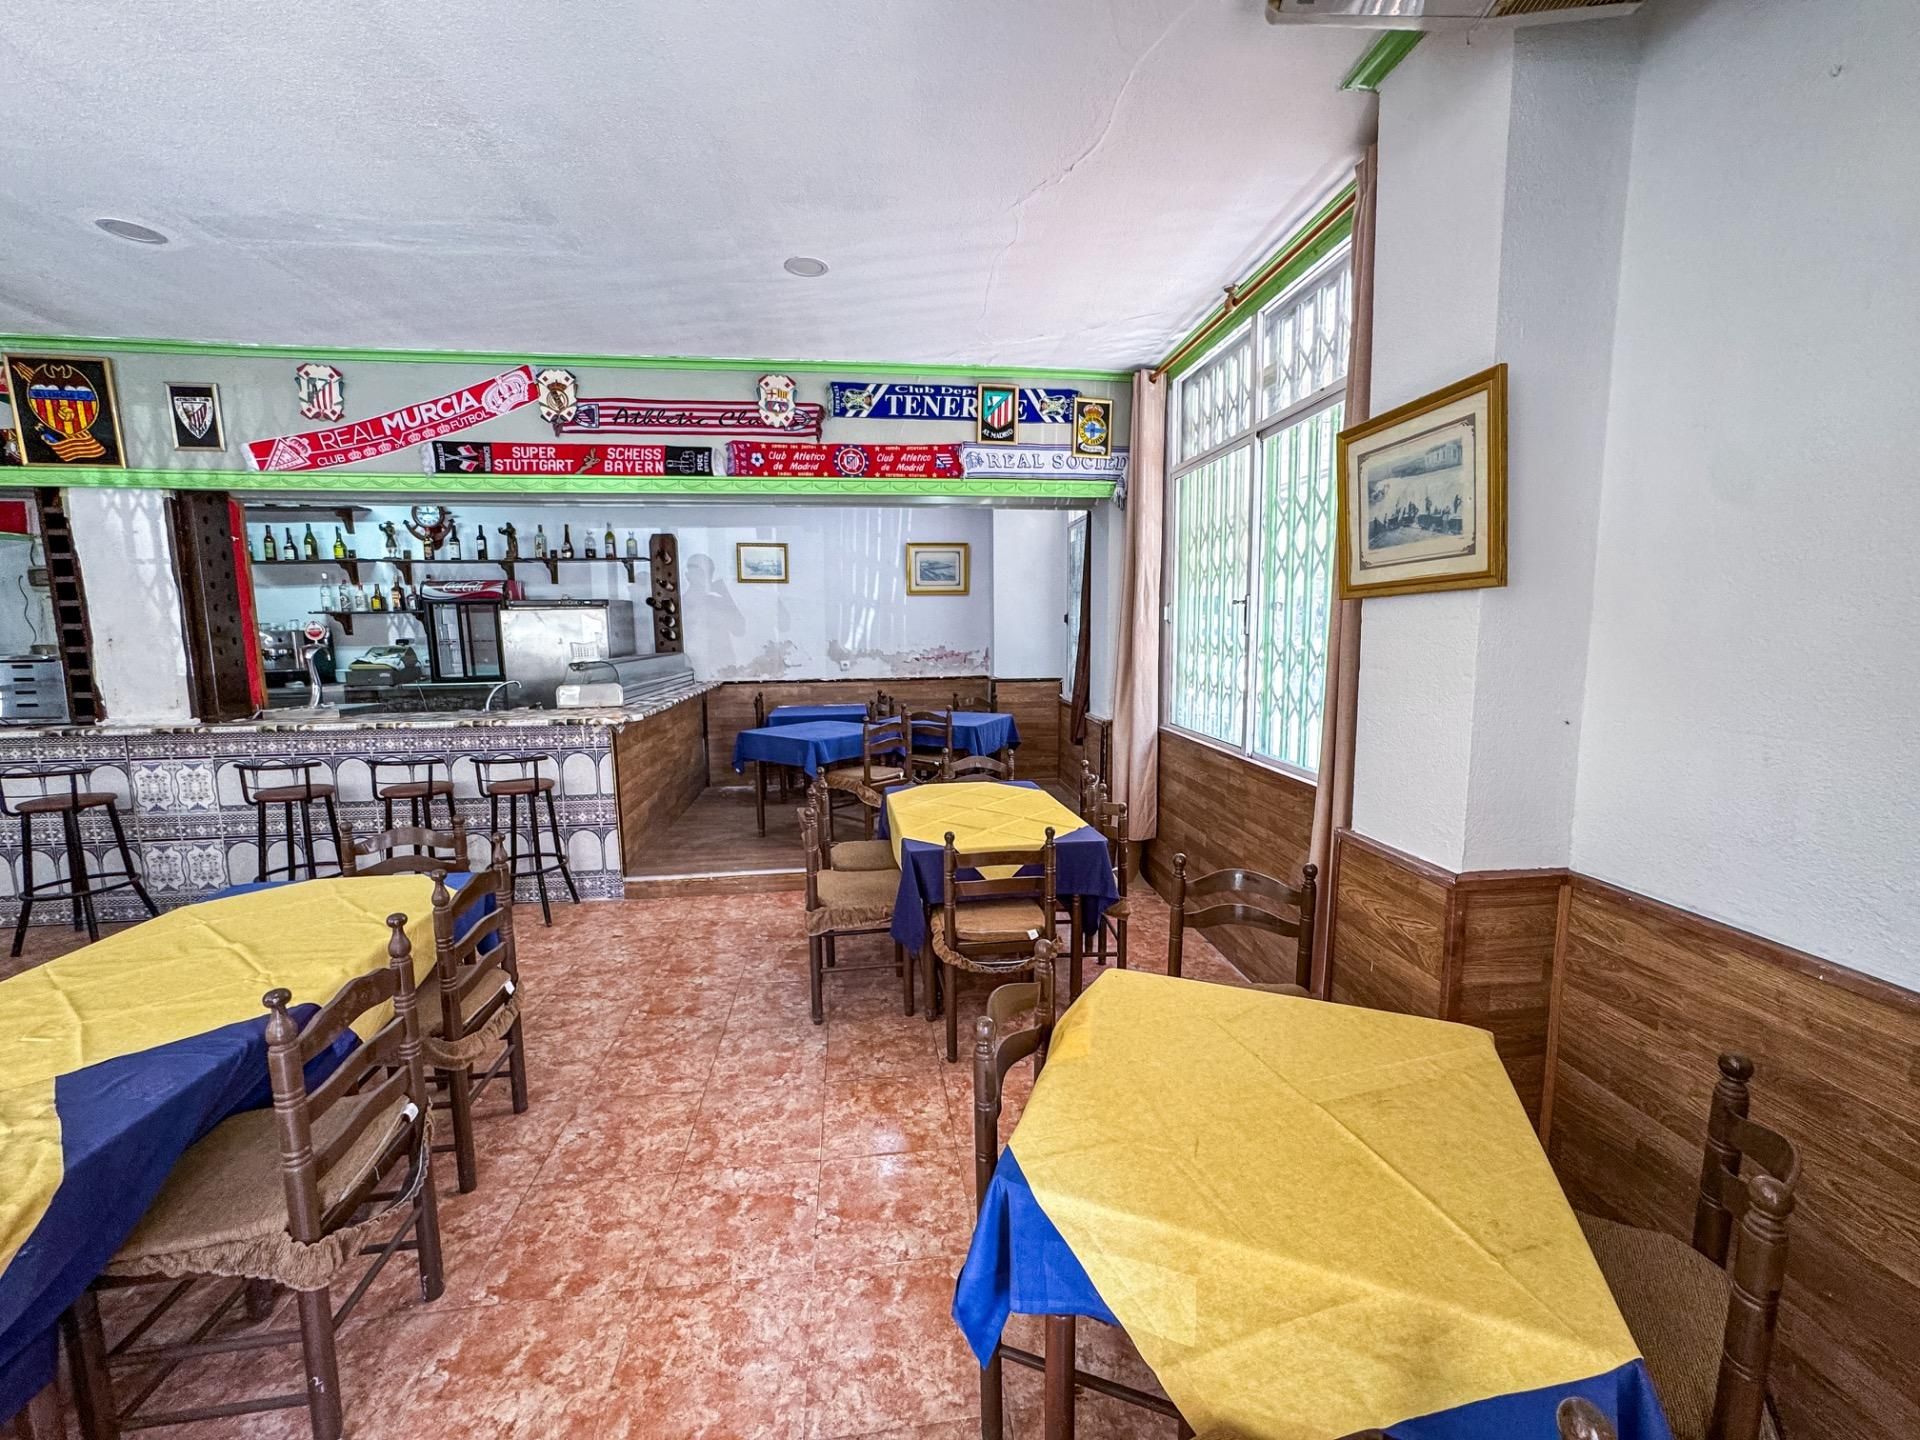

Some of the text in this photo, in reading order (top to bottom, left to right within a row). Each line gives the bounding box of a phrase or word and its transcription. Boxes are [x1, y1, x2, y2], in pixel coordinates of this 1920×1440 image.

[895, 386, 978, 396] Club Depo
[885, 394, 1028, 420] TENERE
[317, 391, 482, 450] REAL MURCIA
[612, 406, 761, 427] Athletic Clu
[317, 455, 346, 467] CLUB
[450, 410, 490, 430] FÚTBOL
[512, 446, 556, 459] SUPER
[607, 447, 662, 460] SCHEISS
[768, 451, 787, 460] Club
[876, 453, 894, 462] Club
[494, 459, 574, 472] STUTTGART
[604, 460, 664, 473] BAYERN
[773, 462, 819, 471] de Madrid
[896, 463, 925, 472] Madrid
[986, 453, 1045, 469] REAL
